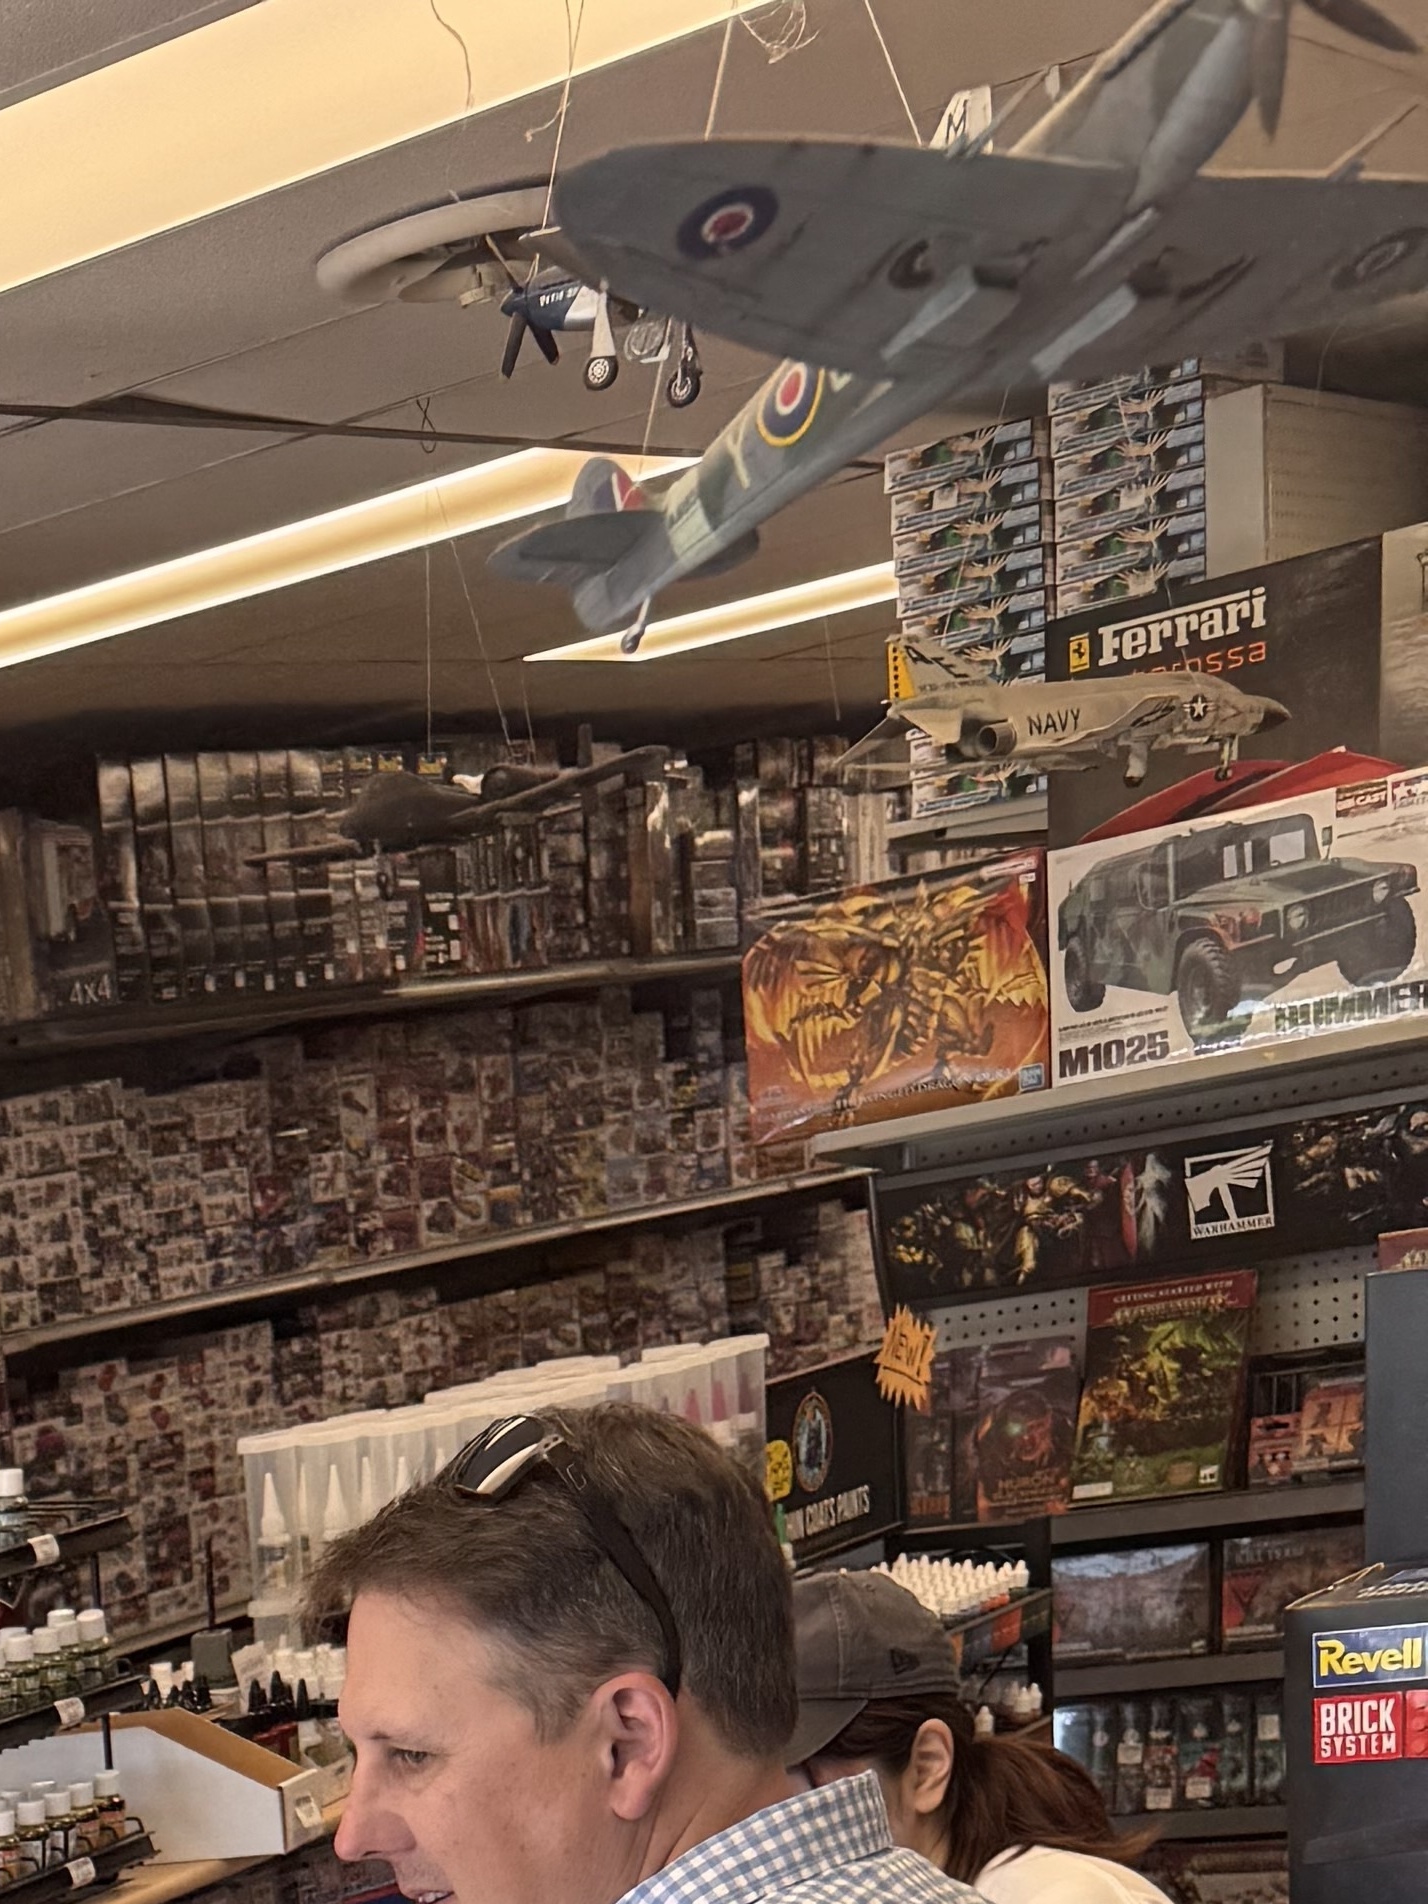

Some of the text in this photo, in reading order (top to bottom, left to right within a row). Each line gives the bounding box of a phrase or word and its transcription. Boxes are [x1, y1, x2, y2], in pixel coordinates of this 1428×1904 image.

[1098, 586, 1268, 668] Ferrari
[1027, 706, 1082, 738] NAVY
[1058, 1030, 1171, 1078] M1025
[1192, 1216, 1274, 1237] WARHAMMER
[1318, 1636, 1423, 1677] Revell
[1320, 1698, 1396, 1737] BRICK
[1320, 1733, 1398, 1759] SYSTEM
